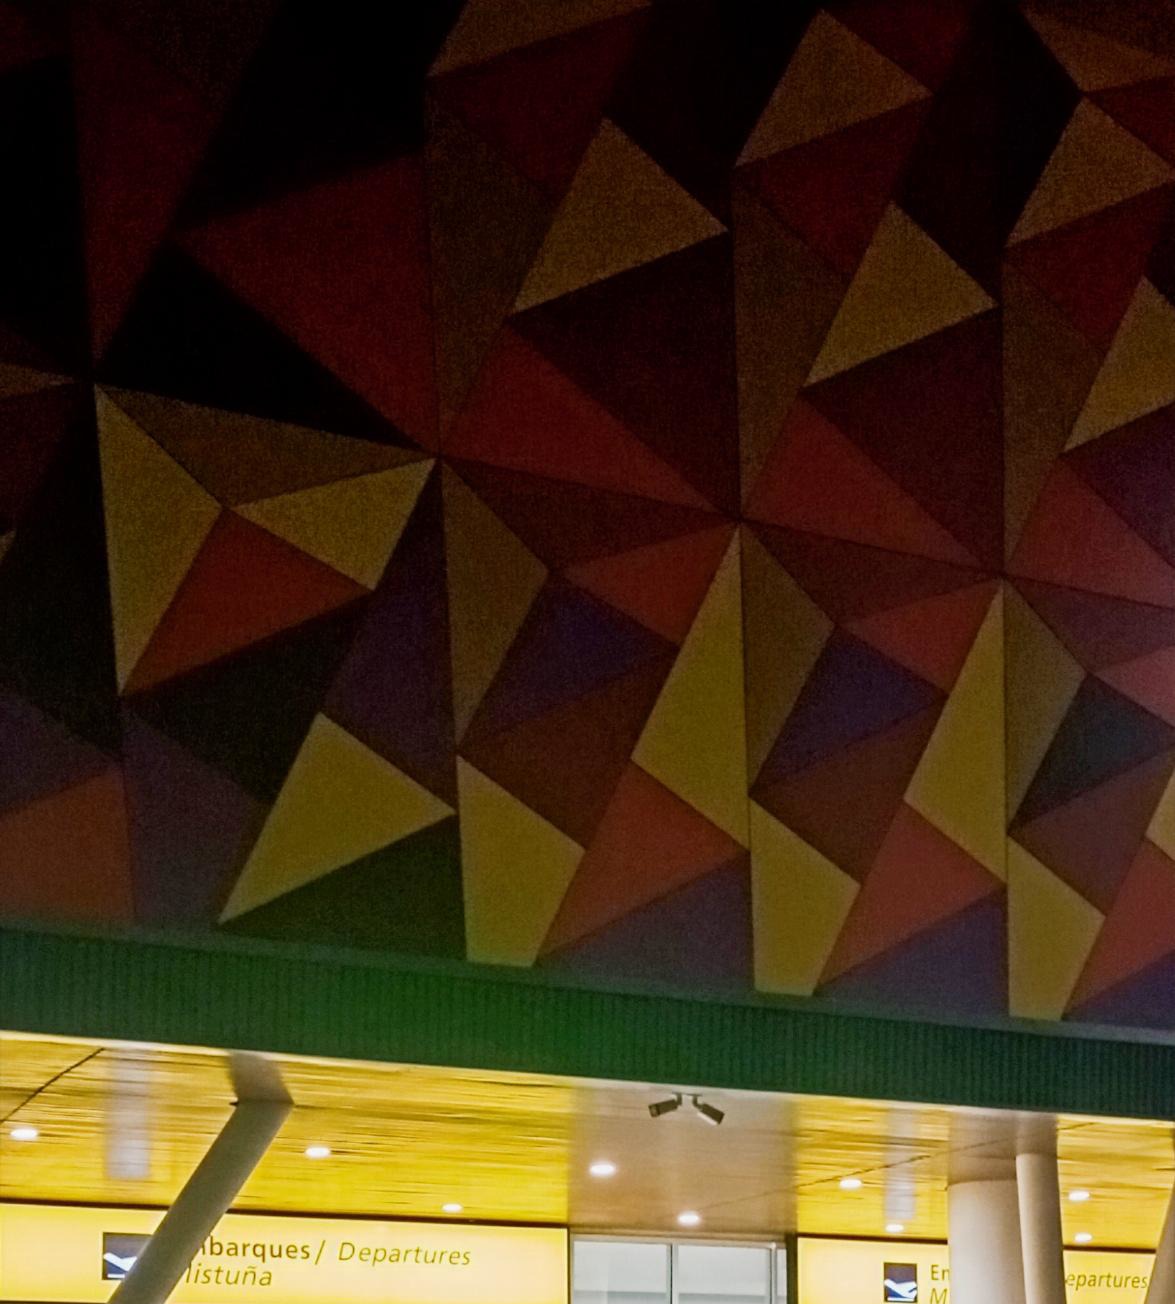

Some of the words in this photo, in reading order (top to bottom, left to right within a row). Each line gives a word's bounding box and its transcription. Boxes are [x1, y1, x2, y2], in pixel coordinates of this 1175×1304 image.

[201, 1235, 326, 1265] barques/
[338, 1241, 471, 1267] Departures
[185, 1262, 273, 1287] istuña
[1064, 1272, 1148, 1291] epartures
